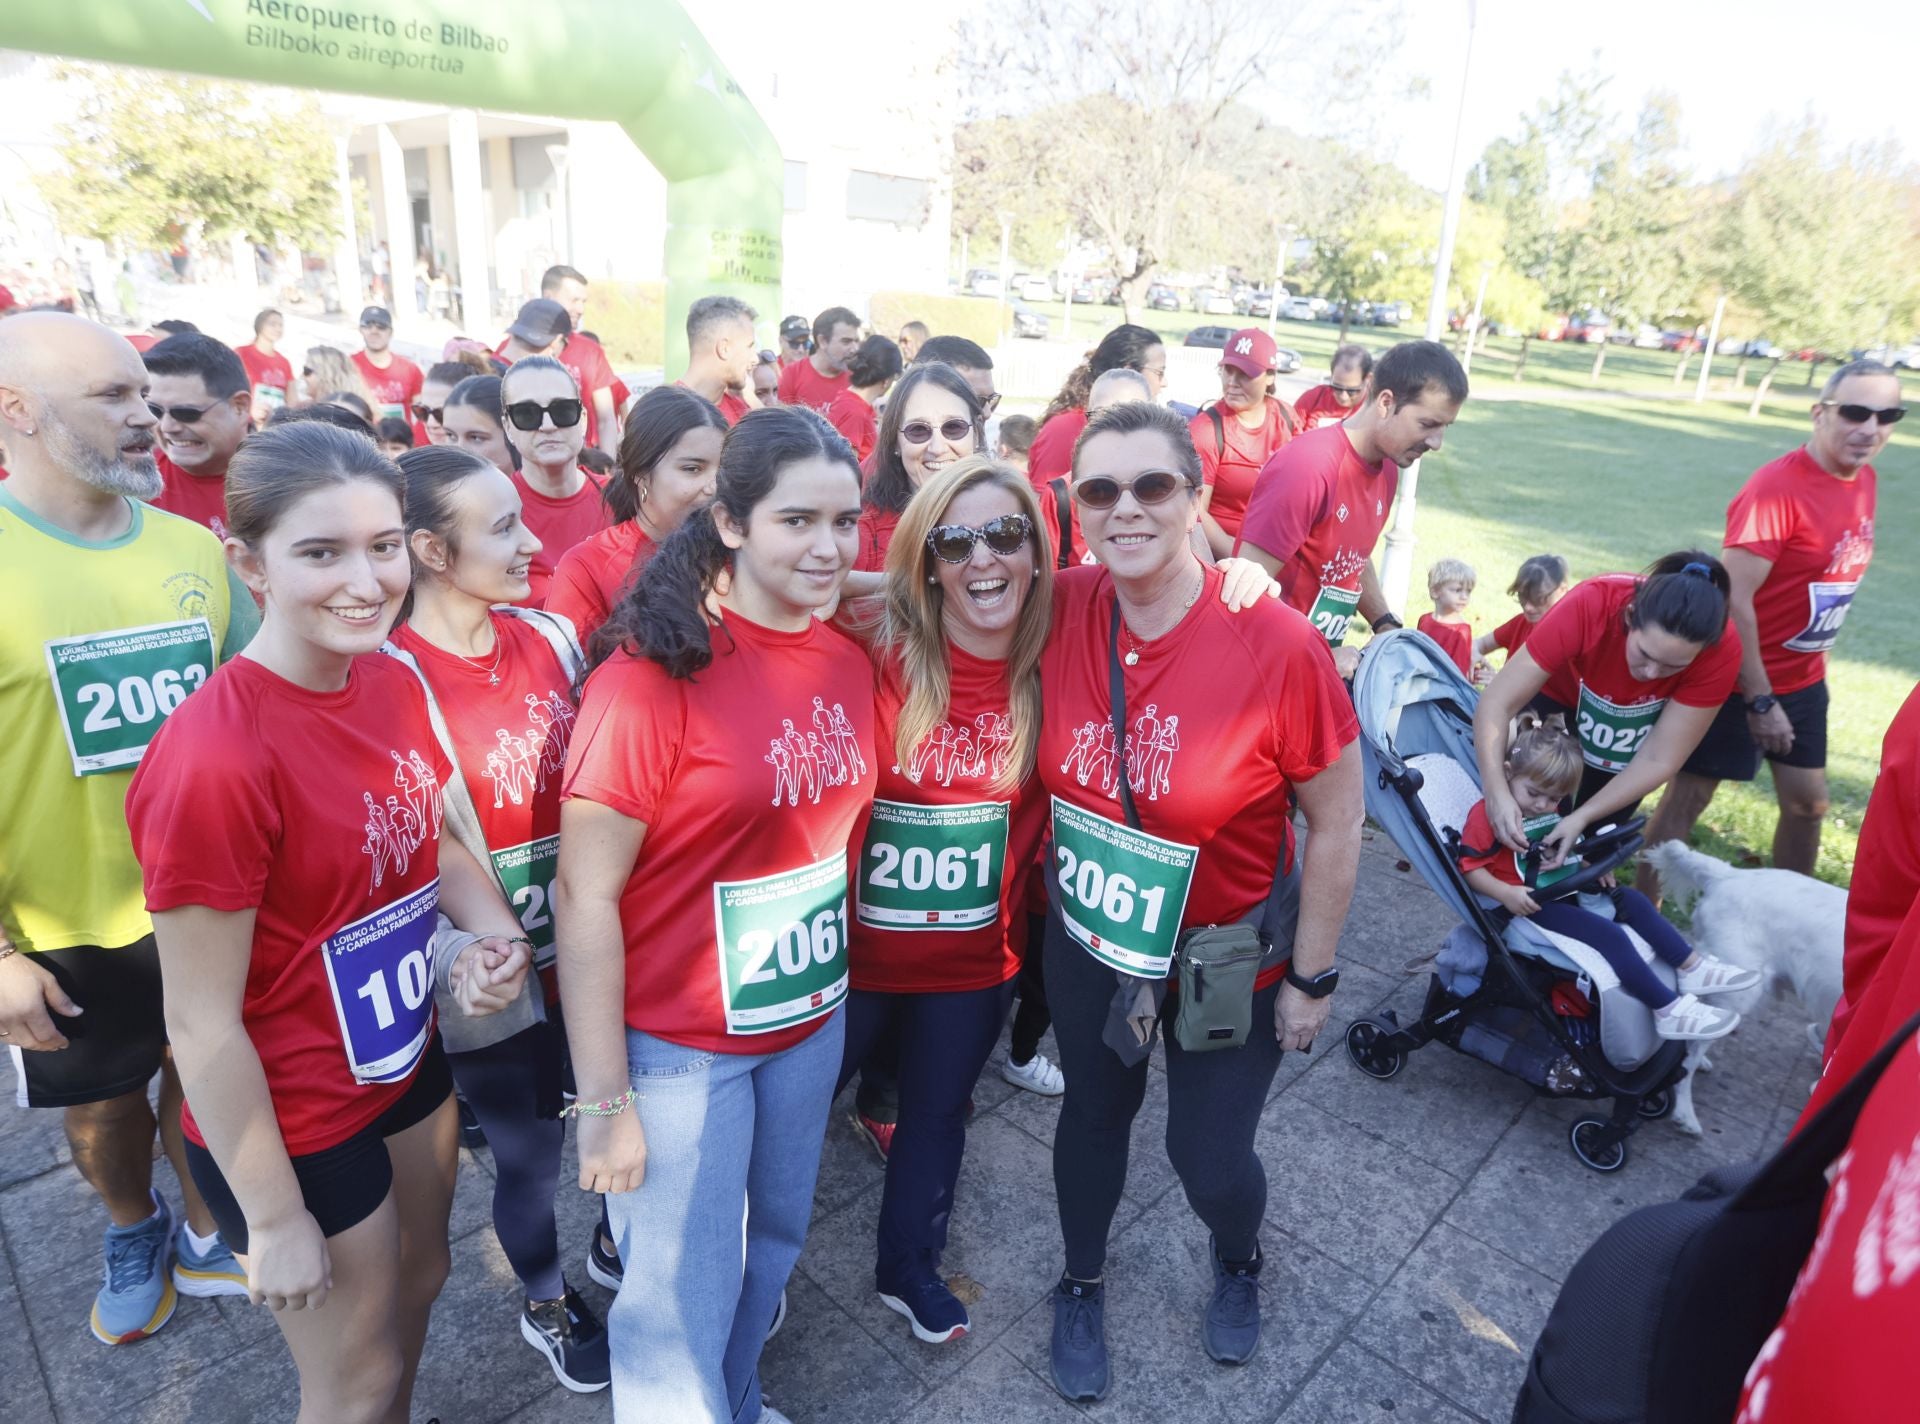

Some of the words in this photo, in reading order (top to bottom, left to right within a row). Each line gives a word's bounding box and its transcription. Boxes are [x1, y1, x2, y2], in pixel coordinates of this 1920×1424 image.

[247, 0, 396, 37] Aeropuerto
[404, 19, 432, 43] de
[440, 23, 509, 54] Bilbao
[246, 24, 340, 57] Bilboko
[347, 43, 465, 75] aireportua
[57, 646, 87, 656] LOIUKO
[96, 638, 126, 650] FAMILIA
[126, 632, 169, 645] LASTERKETA
[69, 650, 109, 663] CARRERA
[110, 644, 145, 656] FAMILIAR
[146, 638, 183, 649] SOLIDARIA
[183, 634, 194, 642] DE
[874, 812, 907, 824] CARRERA
[908, 818, 942, 826] FAMILIAR
[943, 816, 980, 826] SOLIDARIA
[898, 809, 926, 818] FAMILIA
[926, 810, 970, 819] LASTERKETA
[1056, 804, 1076, 820] LOIUKO
[1082, 818, 1106, 833] FAMILIA
[1107, 828, 1146, 848] LASTERKETA
[496, 850, 524, 862] LOIUKO
[506, 853, 544, 868] CARRERA
[1060, 816, 1088, 834] CARRERA
[1090, 829, 1119, 847] FAMILIAR
[1120, 841, 1157, 861] SOLIDARIA
[1158, 854, 1169, 864] DE
[1170, 858, 1190, 868] LOIU
[869, 842, 992, 891] 2061
[725, 887, 756, 898] LOIUKO
[766, 880, 794, 892] FAMILIA
[734, 892, 777, 906] CARRERA
[1058, 846, 1166, 934] 2061
[334, 928, 368, 948] LOIUKO
[376, 908, 406, 928] FAMILIA
[346, 927, 390, 952] CARRERA
[390, 908, 424, 932] FAMILIAR
[738, 897, 848, 985] 2061
